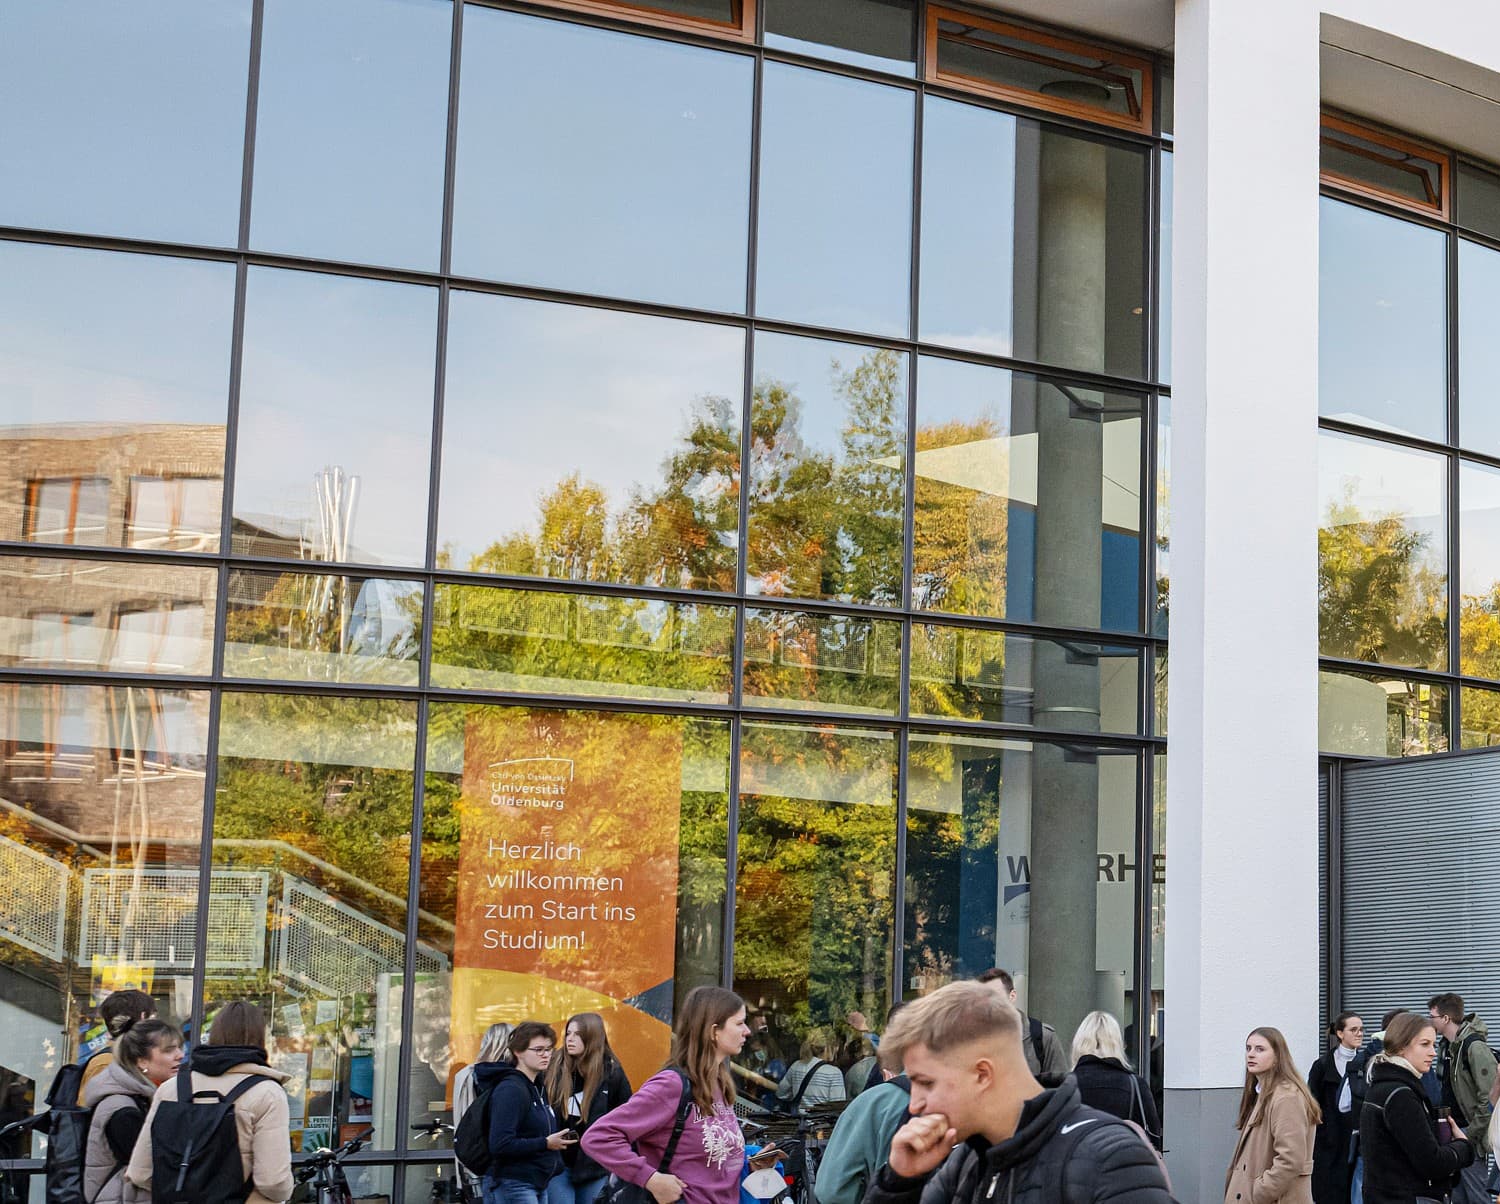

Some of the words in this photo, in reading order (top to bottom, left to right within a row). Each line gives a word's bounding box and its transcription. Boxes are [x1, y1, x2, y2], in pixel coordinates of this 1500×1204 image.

[491, 782, 566, 795] Universität
[490, 794, 564, 811] Oldenburg
[487, 838, 582, 861] Herzlich
[486, 870, 624, 891] willkommen
[484, 903, 534, 920] zum
[541, 900, 598, 921] Start
[604, 901, 636, 921] ins
[483, 929, 586, 950] Studium!
